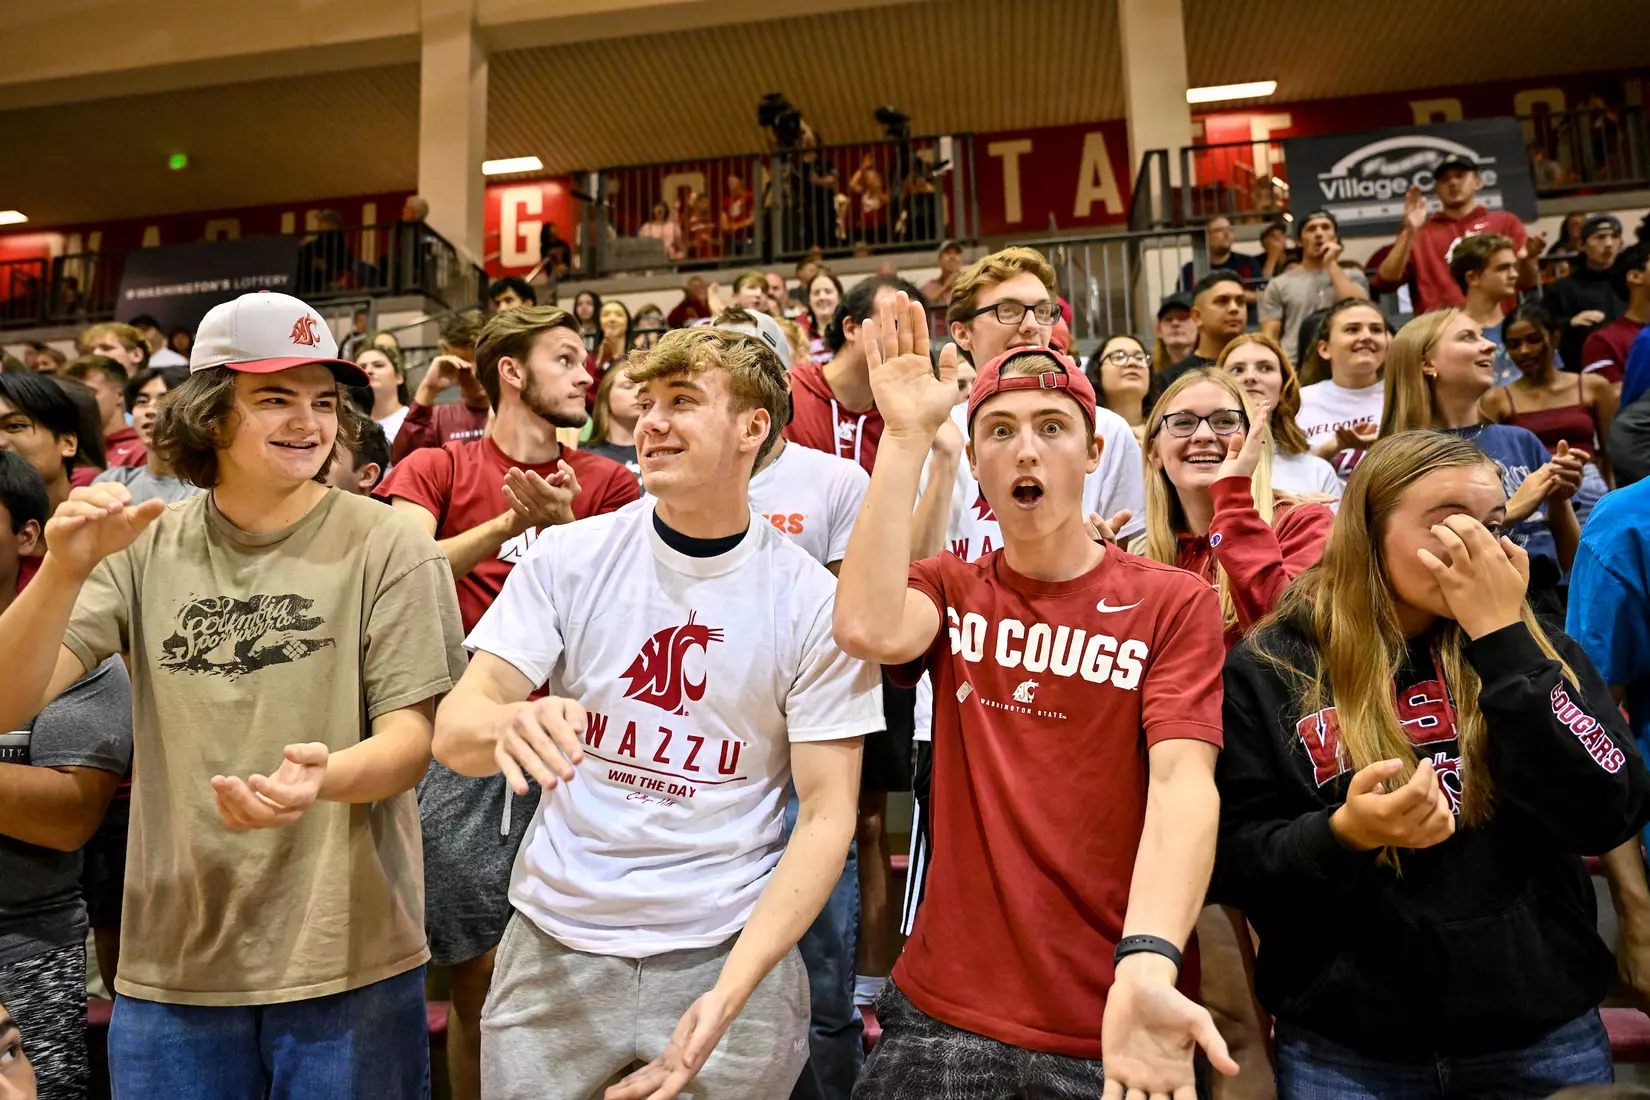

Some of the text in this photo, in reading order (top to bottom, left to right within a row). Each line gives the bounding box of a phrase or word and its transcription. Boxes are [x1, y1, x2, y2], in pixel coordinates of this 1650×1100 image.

[1319, 171, 1409, 201] Village
[233, 274, 290, 291] LOTTERY
[761, 512, 806, 535] RS
[176, 595, 291, 636] Columbia
[994, 617, 1150, 691] COUGS
[980, 697, 1033, 715] WASHINGTON
[1550, 680, 1626, 774] COUGARS
[584, 711, 742, 776] WAZZU
[607, 769, 697, 798] WIN THE DAY
